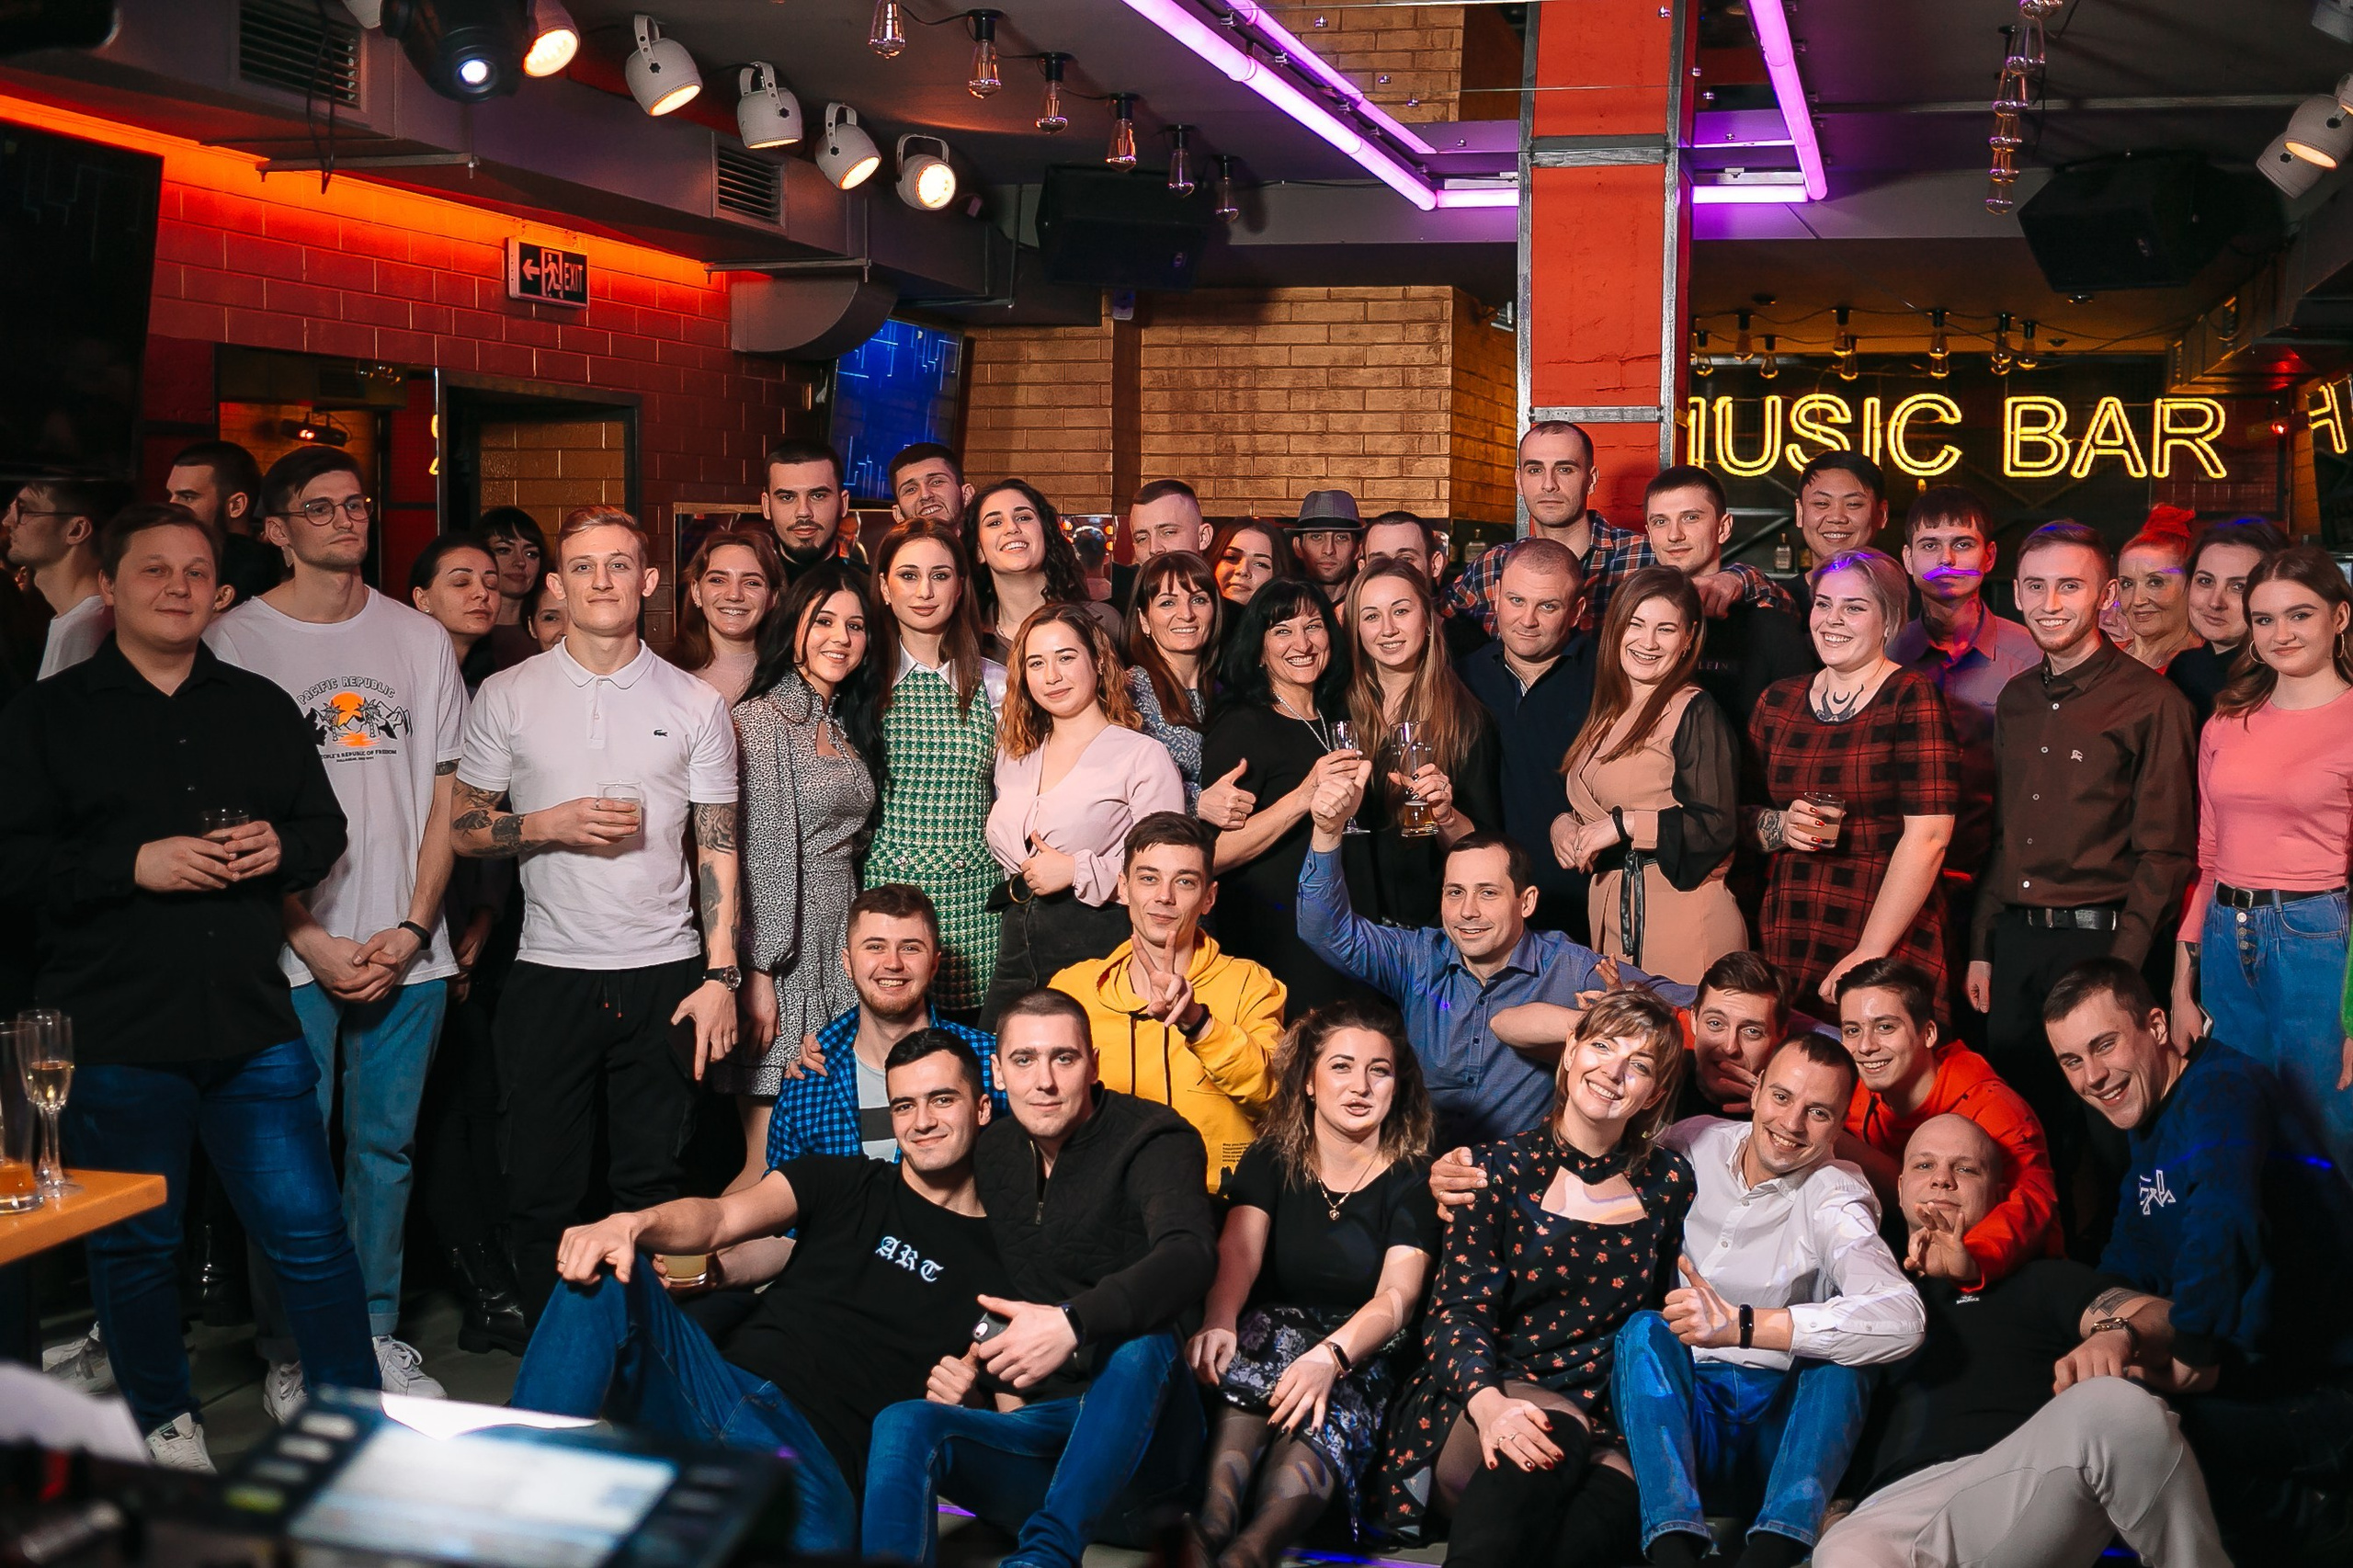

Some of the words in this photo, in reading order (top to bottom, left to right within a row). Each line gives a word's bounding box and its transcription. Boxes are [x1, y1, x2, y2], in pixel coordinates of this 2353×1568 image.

[564, 262, 584, 292] EXIT
[2004, 395, 2227, 479] BAR
[1698, 661, 1728, 670] LEIN
[297, 678, 338, 705] PACIFIC
[342, 676, 395, 699] REPUBLIC
[875, 1235, 944, 1282] ART
